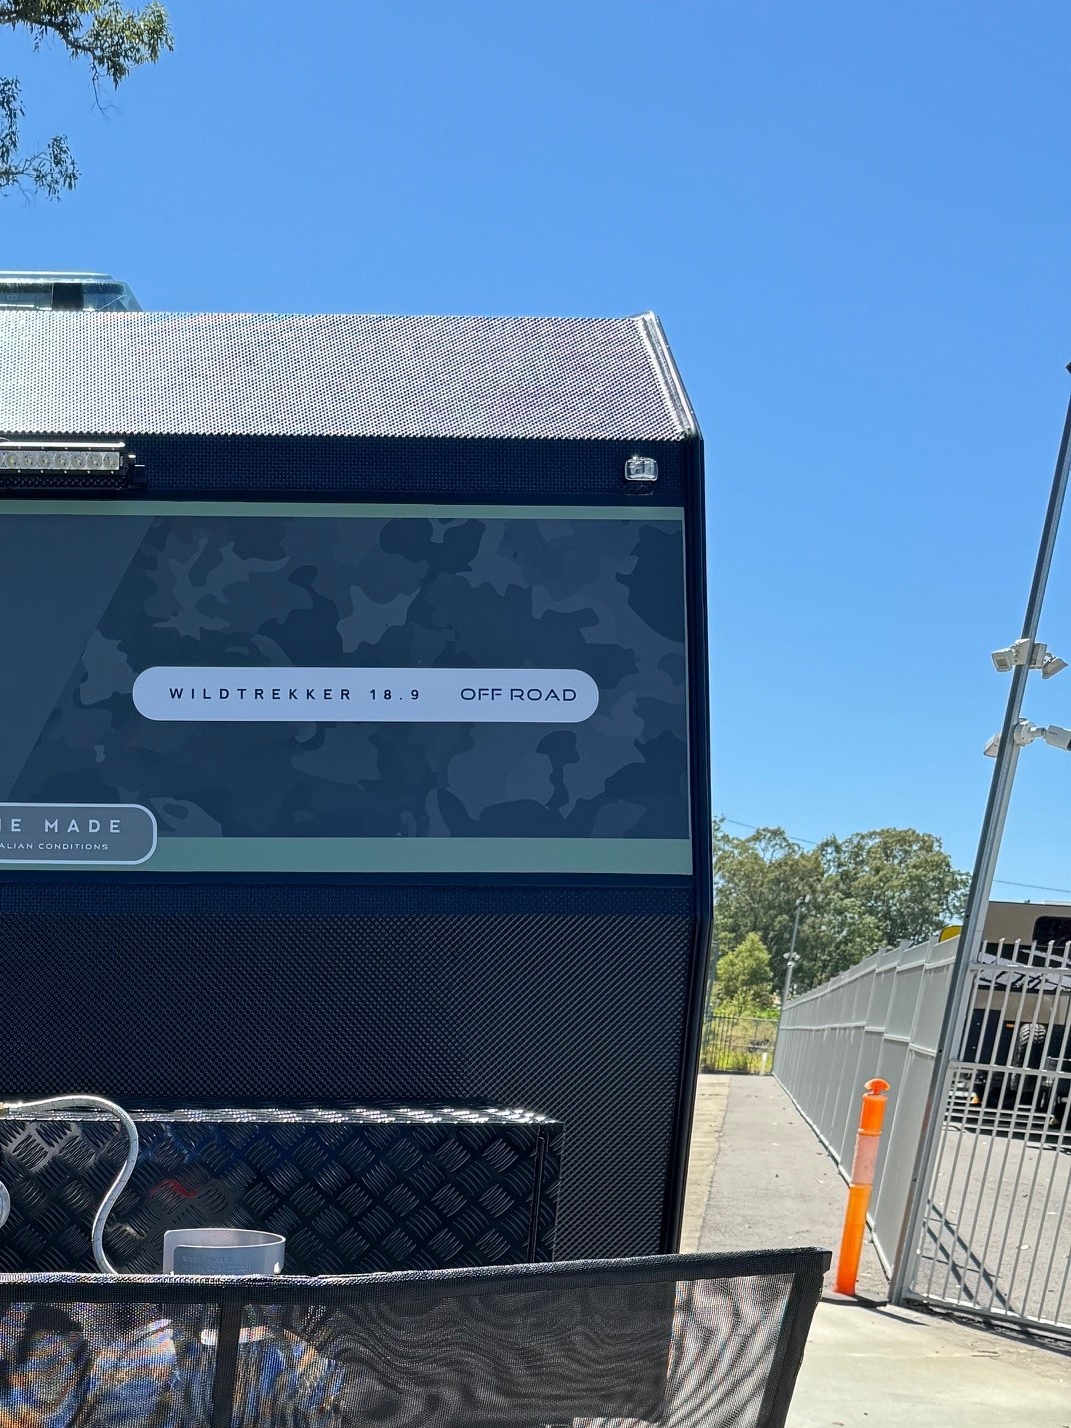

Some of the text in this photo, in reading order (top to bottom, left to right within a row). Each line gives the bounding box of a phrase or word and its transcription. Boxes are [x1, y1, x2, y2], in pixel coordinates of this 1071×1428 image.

[168, 687, 421, 701] WILDTREKKER 18.9
[459, 688, 578, 702] OFF ROAD
[44, 819, 121, 833] MADE
[38, 843, 109, 851] CONDITIONS
